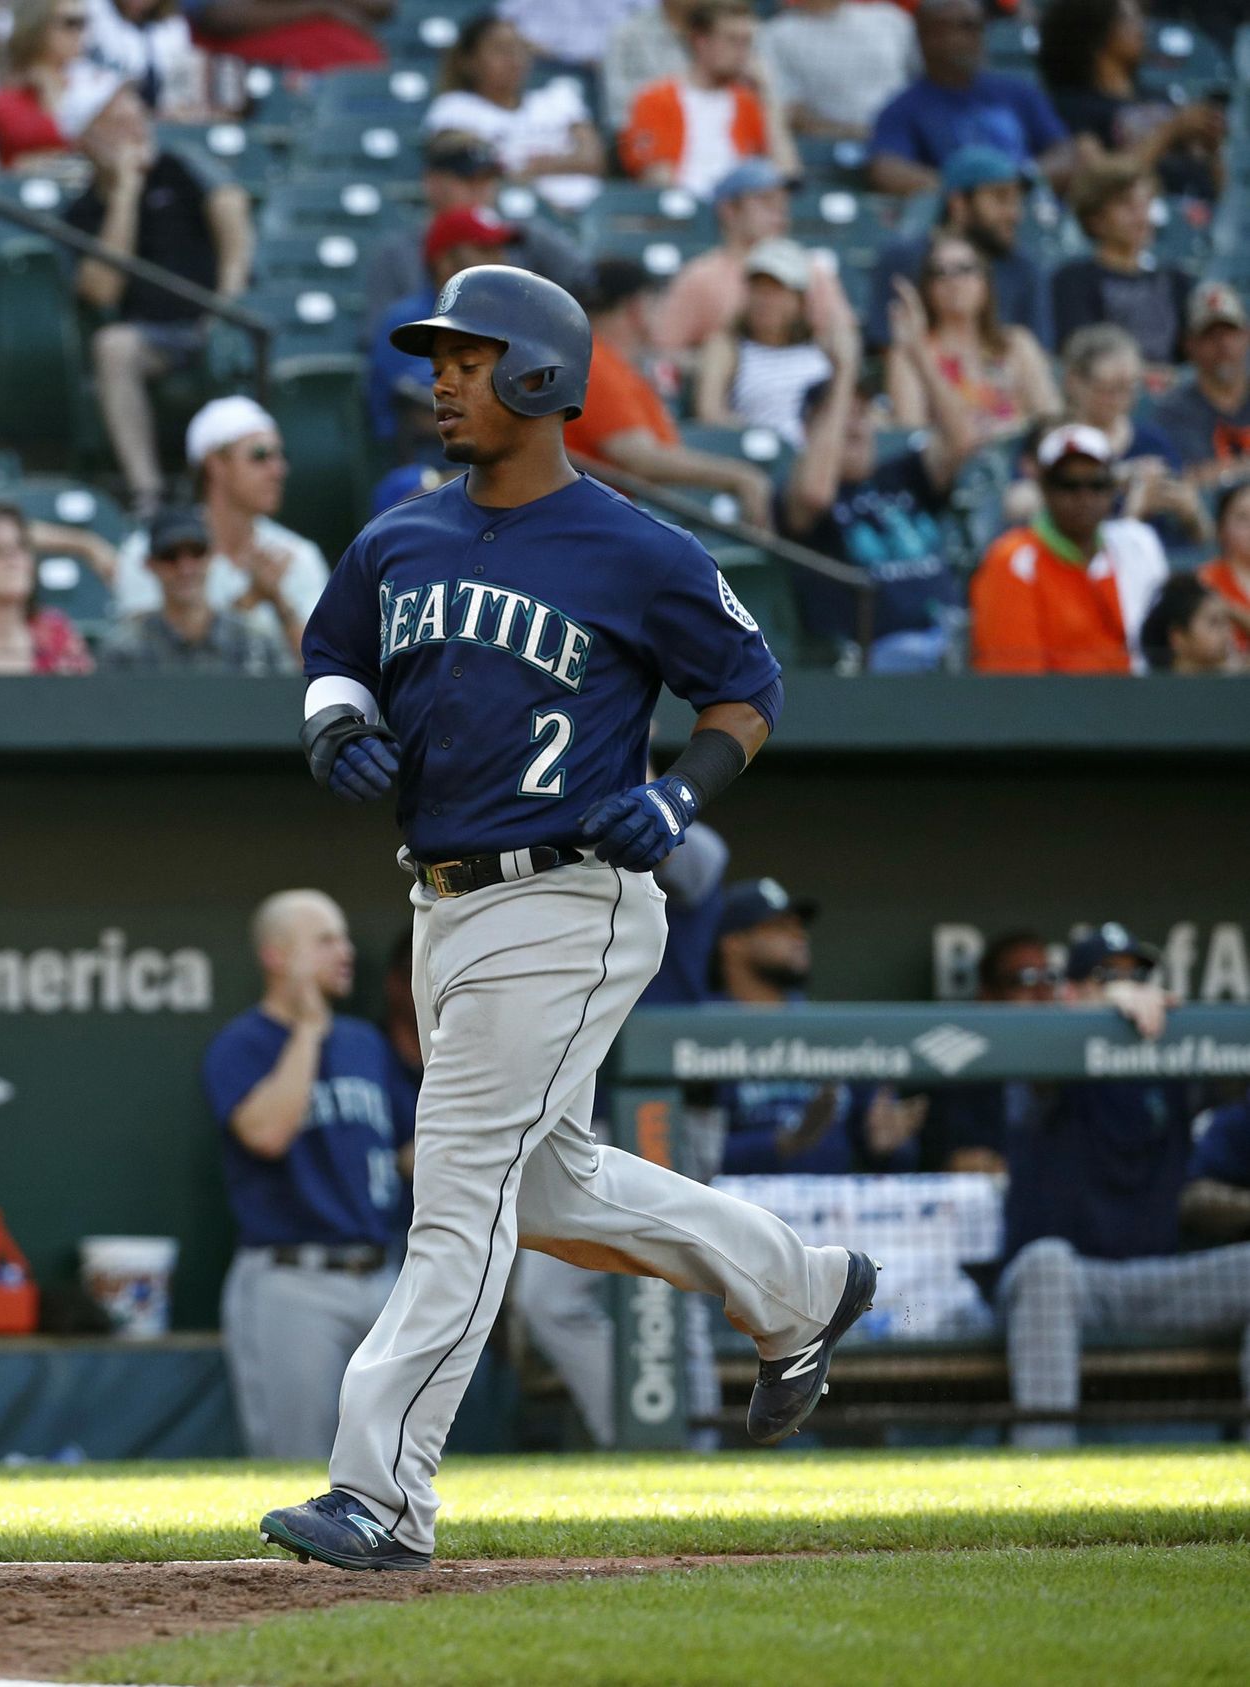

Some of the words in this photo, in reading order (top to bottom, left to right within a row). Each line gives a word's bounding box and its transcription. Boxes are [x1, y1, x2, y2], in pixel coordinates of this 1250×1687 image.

[517, 709, 575, 798] 2
[673, 1039, 747, 1078] Bank
[751, 1039, 785, 1078] of
[787, 1039, 912, 1078] America
[1085, 1037, 1156, 1076] Bank
[1163, 1037, 1194, 1076] of
